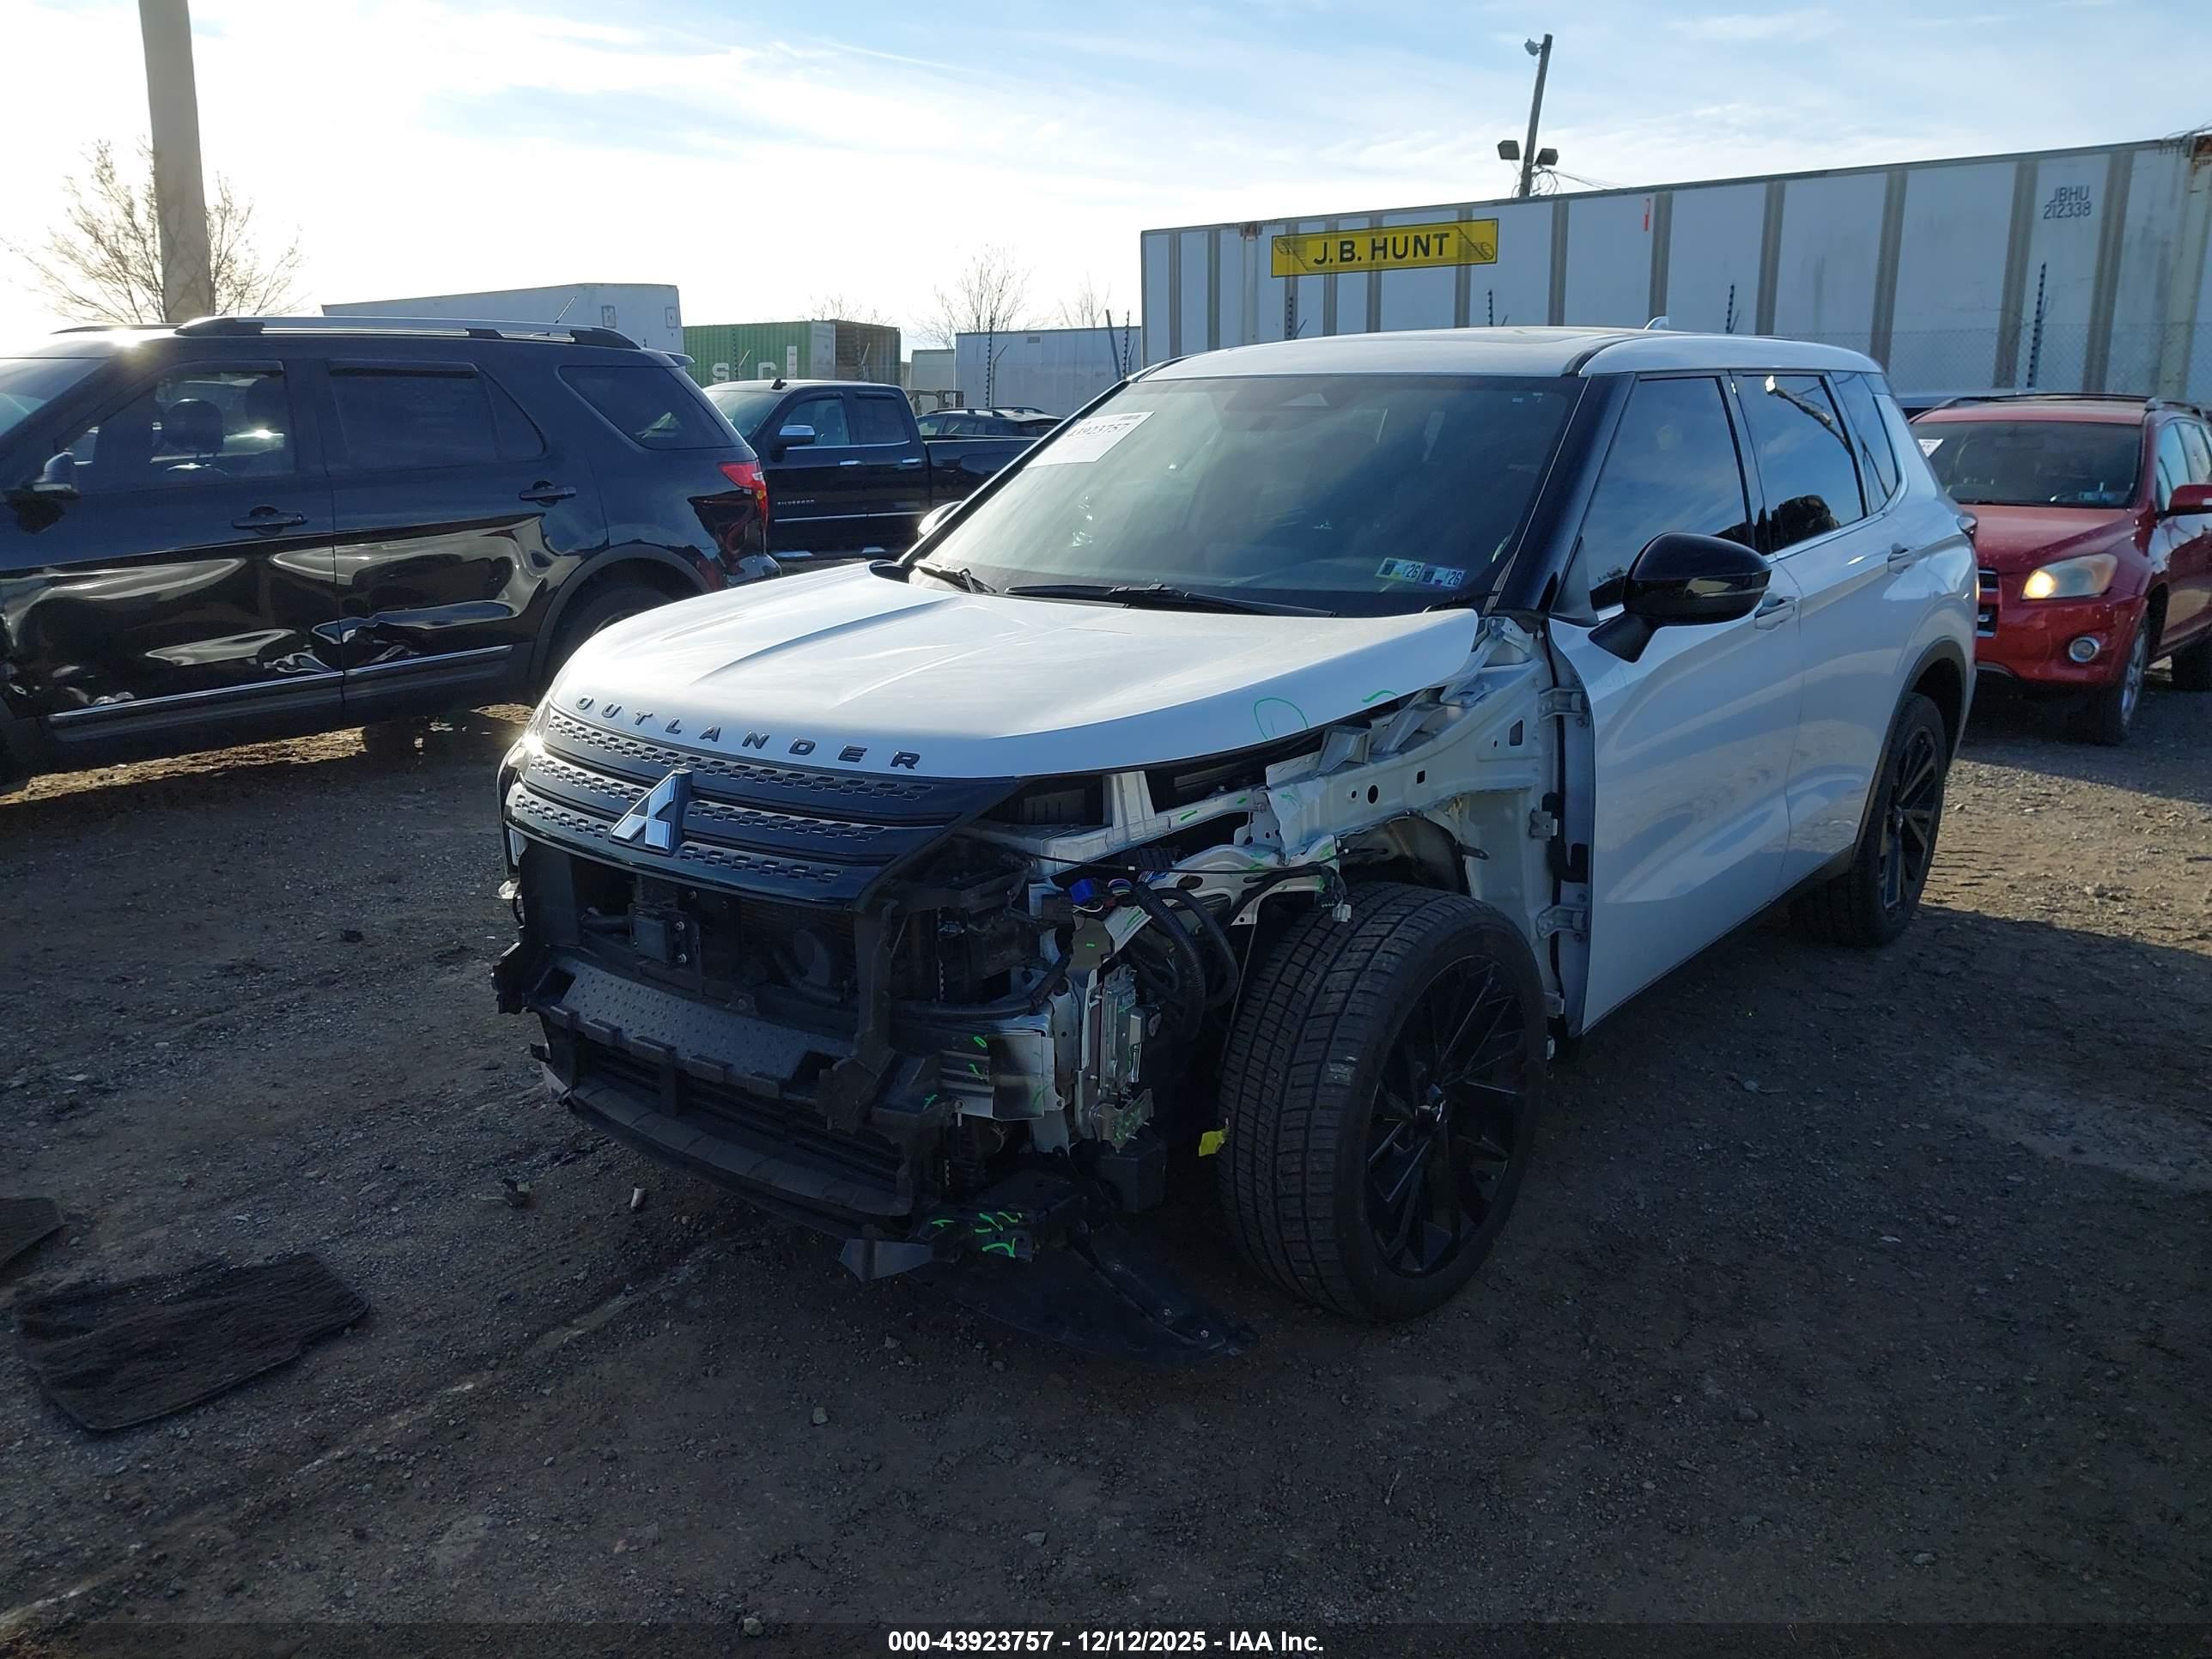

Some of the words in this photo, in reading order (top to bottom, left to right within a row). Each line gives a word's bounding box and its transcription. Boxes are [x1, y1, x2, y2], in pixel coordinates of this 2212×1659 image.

[2050, 185, 2090, 204] JBHU
[2043, 200, 2092, 220] 212338
[1313, 240, 1363, 265] J.B.
[1370, 233, 1450, 261] HUNT
[574, 693, 921, 770] OUTLANDER
